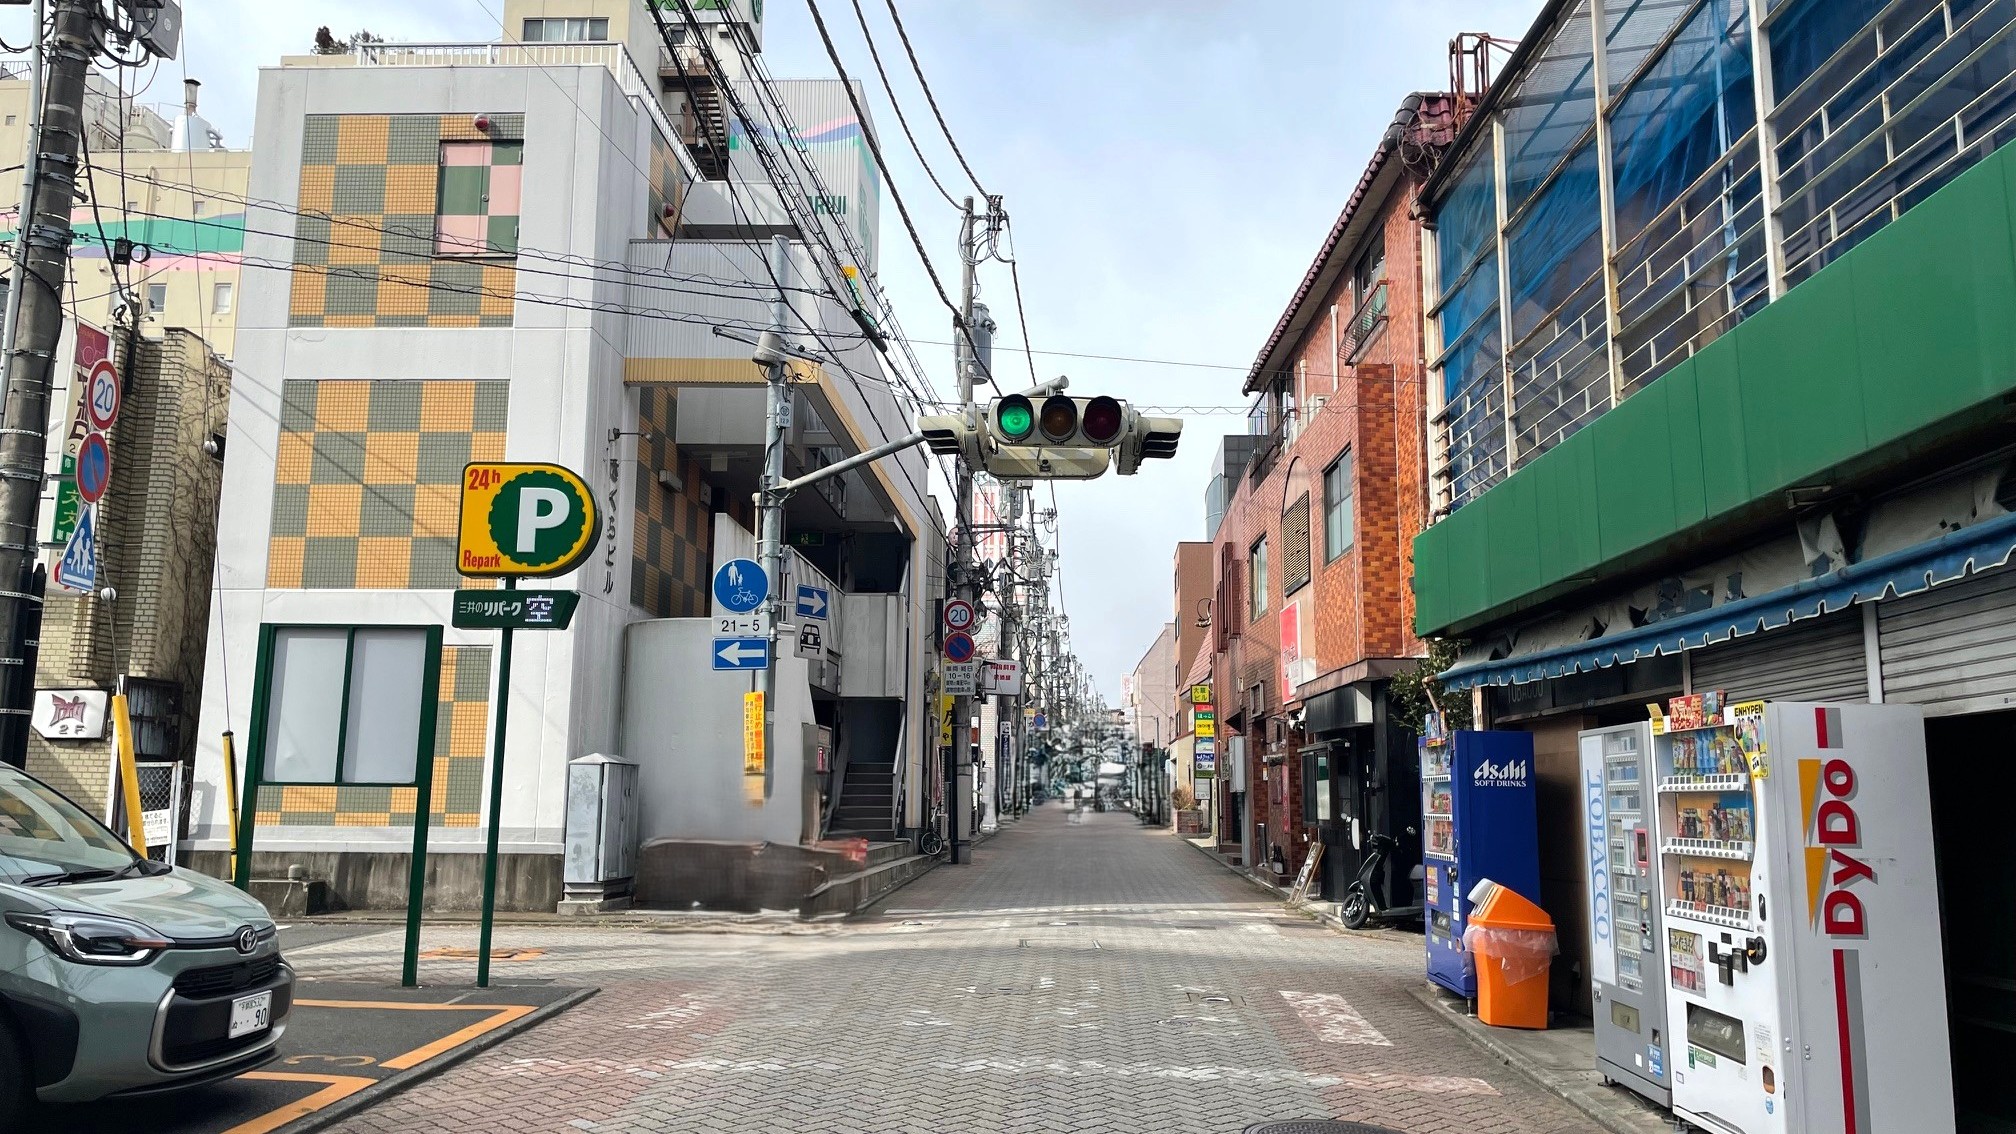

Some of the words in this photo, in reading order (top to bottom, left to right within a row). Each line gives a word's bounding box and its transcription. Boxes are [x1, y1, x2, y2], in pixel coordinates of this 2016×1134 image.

[95, 378, 115, 413] 20
[517, 487, 571, 552] P
[462, 549, 501, 570] Repark
[459, 601, 522, 617] 三井のリパーク
[524, 594, 554, 623] 空
[950, 609, 968, 623] 20
[1734, 704, 1763, 717] ENHYPEN
[1473, 759, 1526, 780] Asahi
[1496, 780, 1527, 788] DRINKS
[1589, 774, 1609, 940] TOBACCO
[1817, 758, 1873, 936] DyDo
